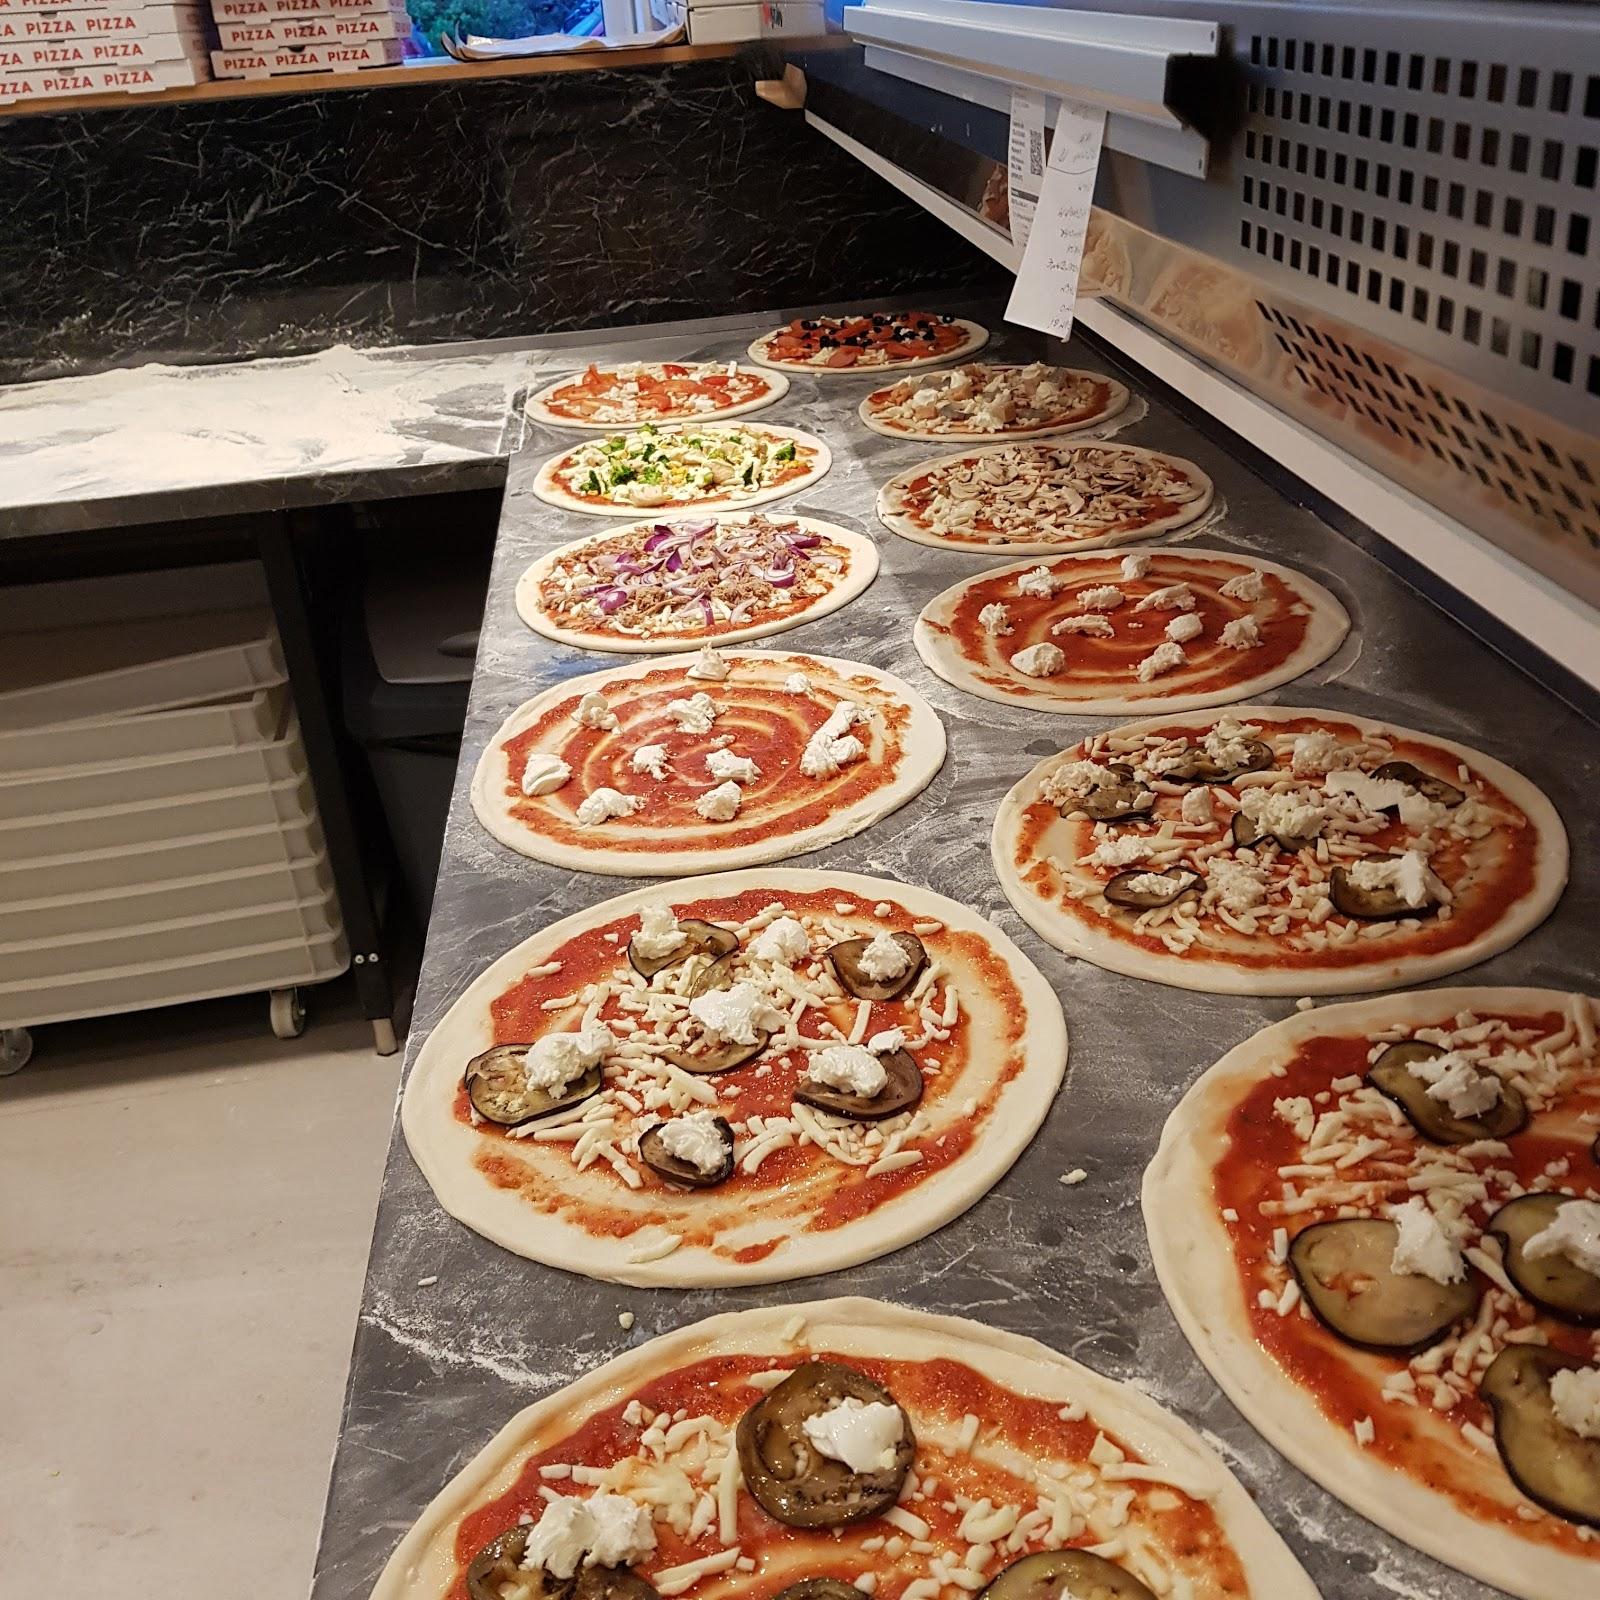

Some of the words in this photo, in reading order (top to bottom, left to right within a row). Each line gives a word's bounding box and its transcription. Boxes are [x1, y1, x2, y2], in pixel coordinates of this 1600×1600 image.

[224, 3, 268, 15] PIZZA
[277, 0, 321, 11] PIZZA
[26, 21, 76, 34] PIZZA
[86, 17, 136, 31] PIZZA
[232, 29, 275, 42] PIZZA
[284, 25, 327, 38] PIZZA
[336, 22, 379, 34] PIZZA
[33, 48, 83, 63] PIZZA
[94, 43, 144, 58] PIZZA
[224, 57, 267, 69] PIZZA
[276, 53, 319, 66] PIZZA
[328, 49, 370, 61] PIZZA
[43, 76, 94, 91] PIZZA
[104, 70, 154, 86] PIZZA
